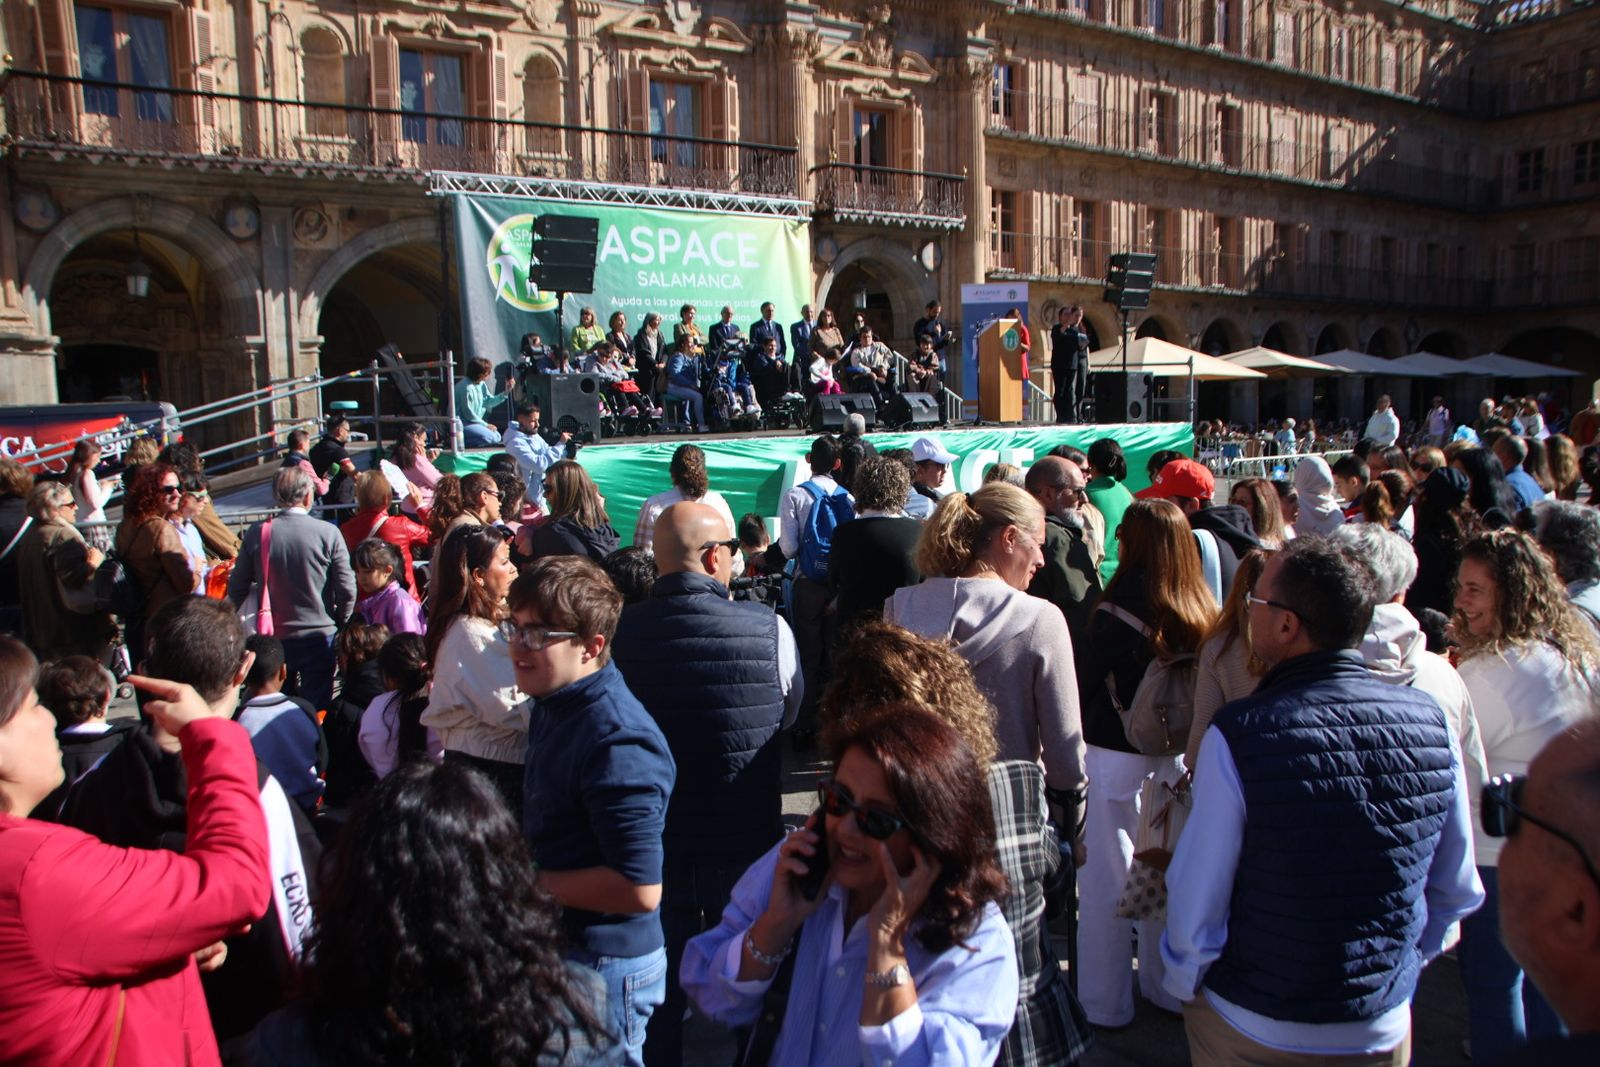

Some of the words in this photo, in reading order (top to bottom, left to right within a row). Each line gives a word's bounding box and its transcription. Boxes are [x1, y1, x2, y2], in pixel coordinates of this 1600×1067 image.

[600, 223, 761, 268] ASPACE
[637, 270, 743, 289] SALAMANCA
[610, 295, 643, 308] Ayuda
[644, 298, 651, 306] a
[653, 296, 668, 306] las
